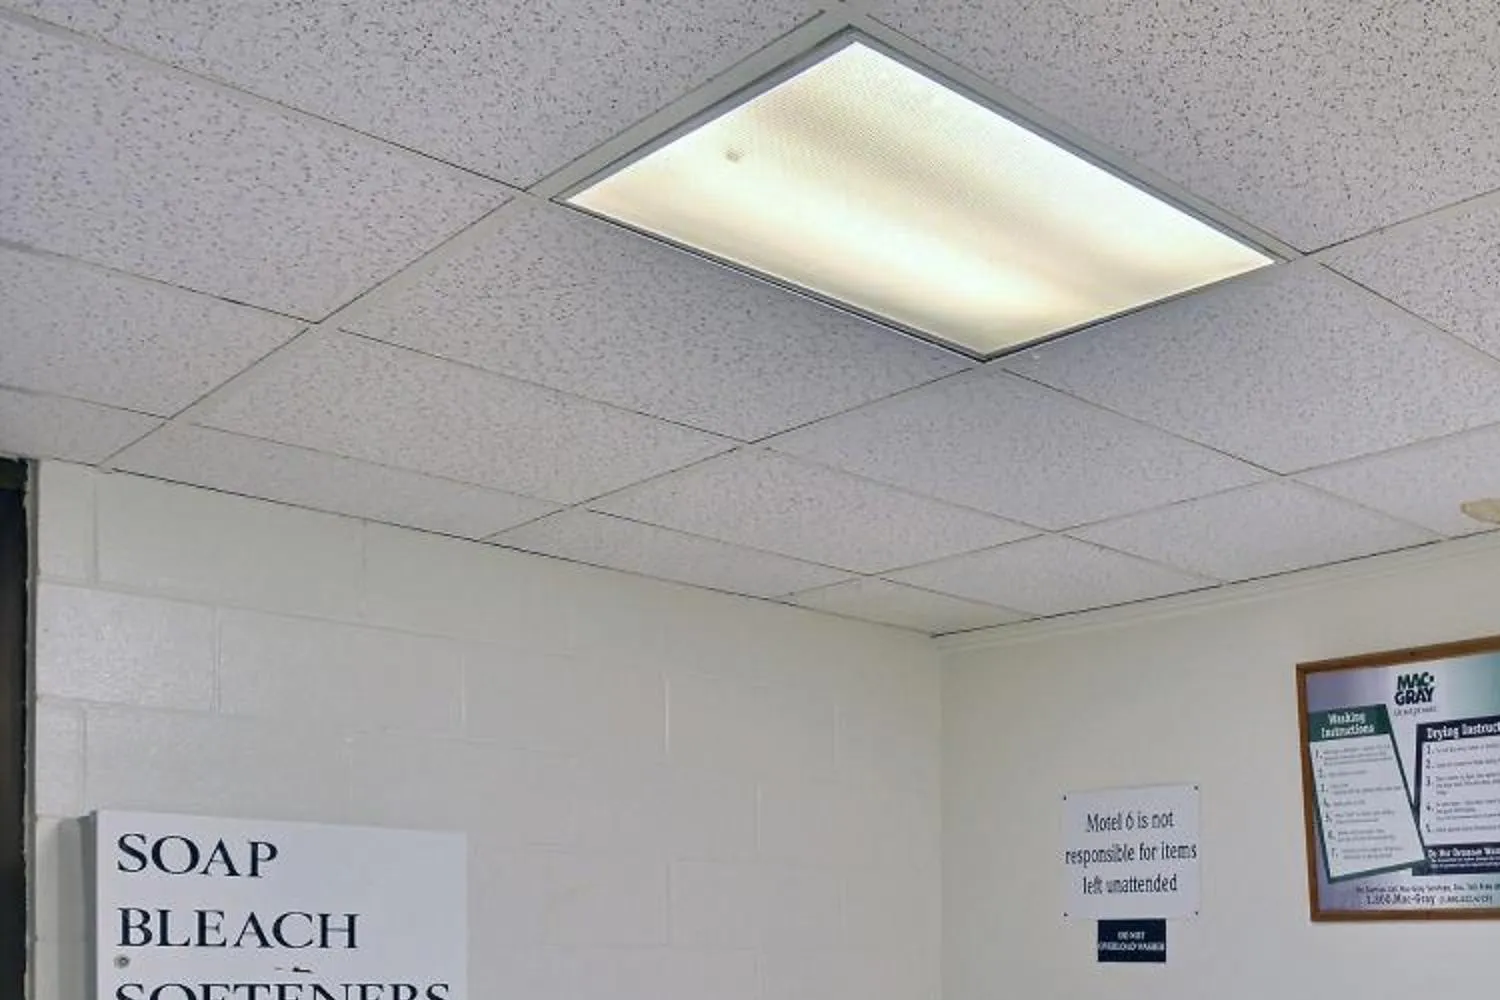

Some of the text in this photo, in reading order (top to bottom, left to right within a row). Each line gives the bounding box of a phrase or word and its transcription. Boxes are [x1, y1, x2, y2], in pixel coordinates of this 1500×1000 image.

[1394, 687, 1435, 706] GRAY
[1085, 811, 1174, 832] Motel 6 is not
[117, 833, 278, 878] SOAP
[1065, 840, 1197, 869] responsible for items
[1082, 873, 1178, 895] left unattended
[116, 907, 361, 949] BLEACH
